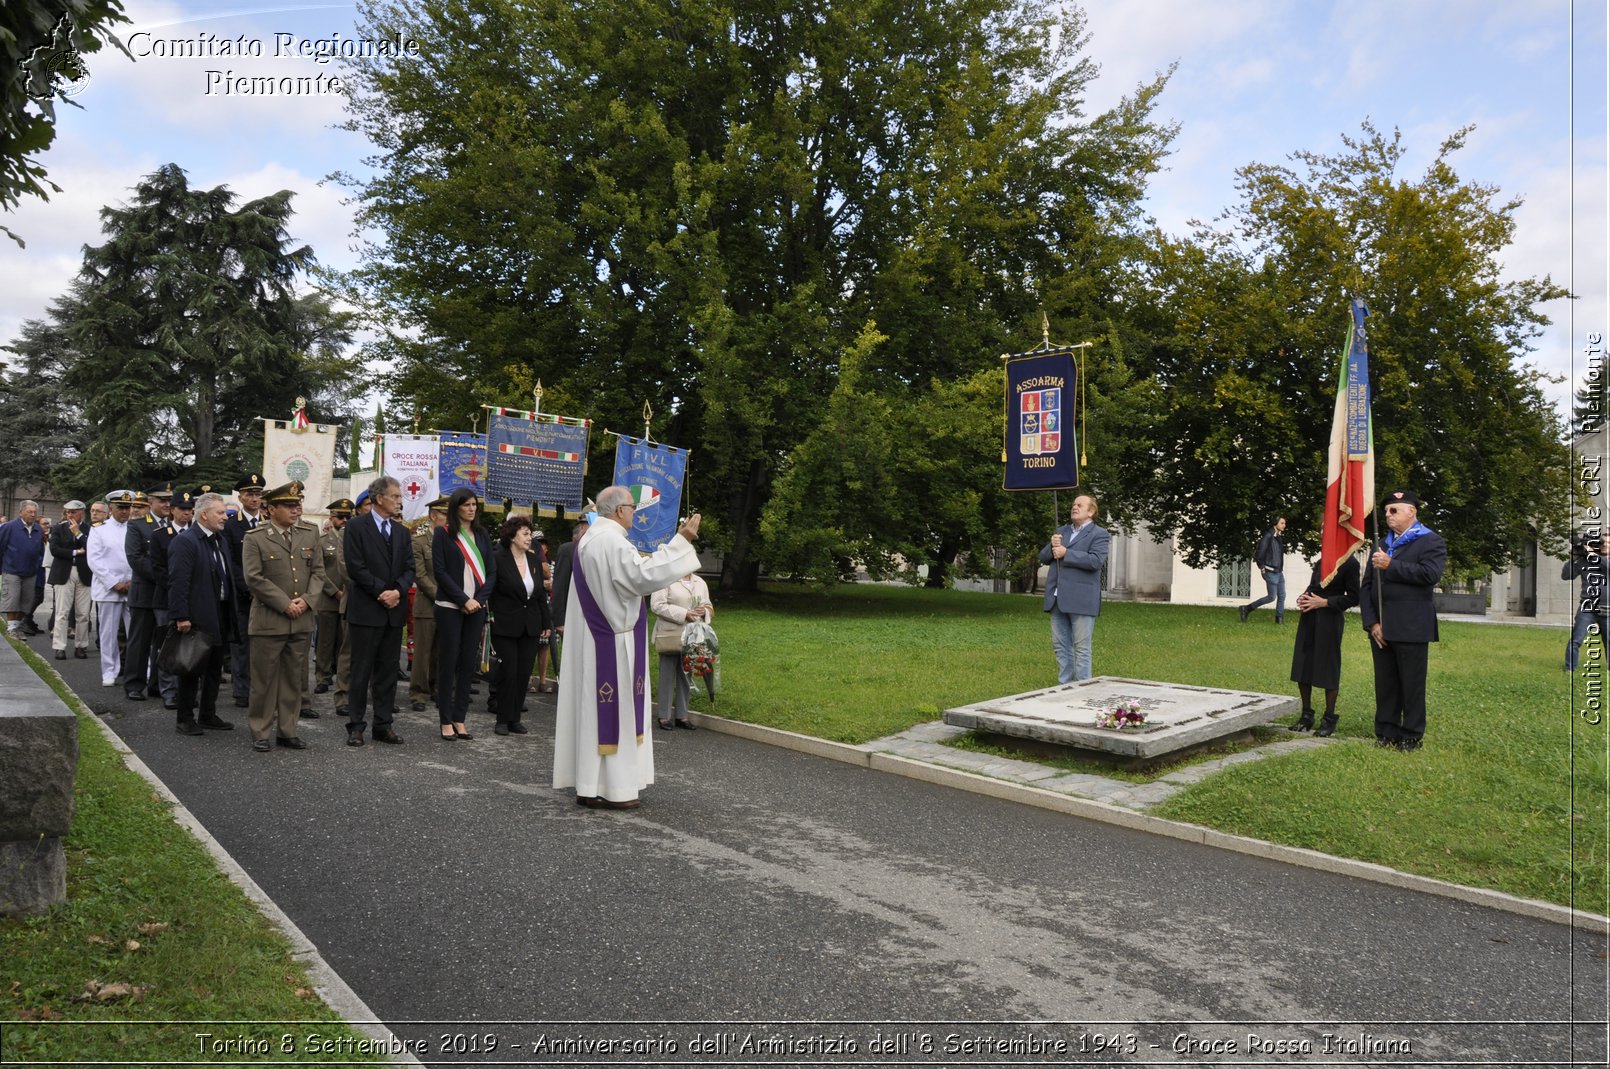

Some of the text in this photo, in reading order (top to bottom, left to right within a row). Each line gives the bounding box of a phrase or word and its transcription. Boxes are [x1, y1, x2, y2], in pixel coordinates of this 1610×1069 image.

[1016, 376, 1065, 393] ASSOARMA
[1349, 383, 1358, 420] COMBATTENTI
[1358, 383, 1367, 419] LIBERAZIONE
[526, 434, 555, 444] PIEMONTE
[1358, 429, 1367, 451] GUERRA
[1022, 457, 1056, 468] TORINO
